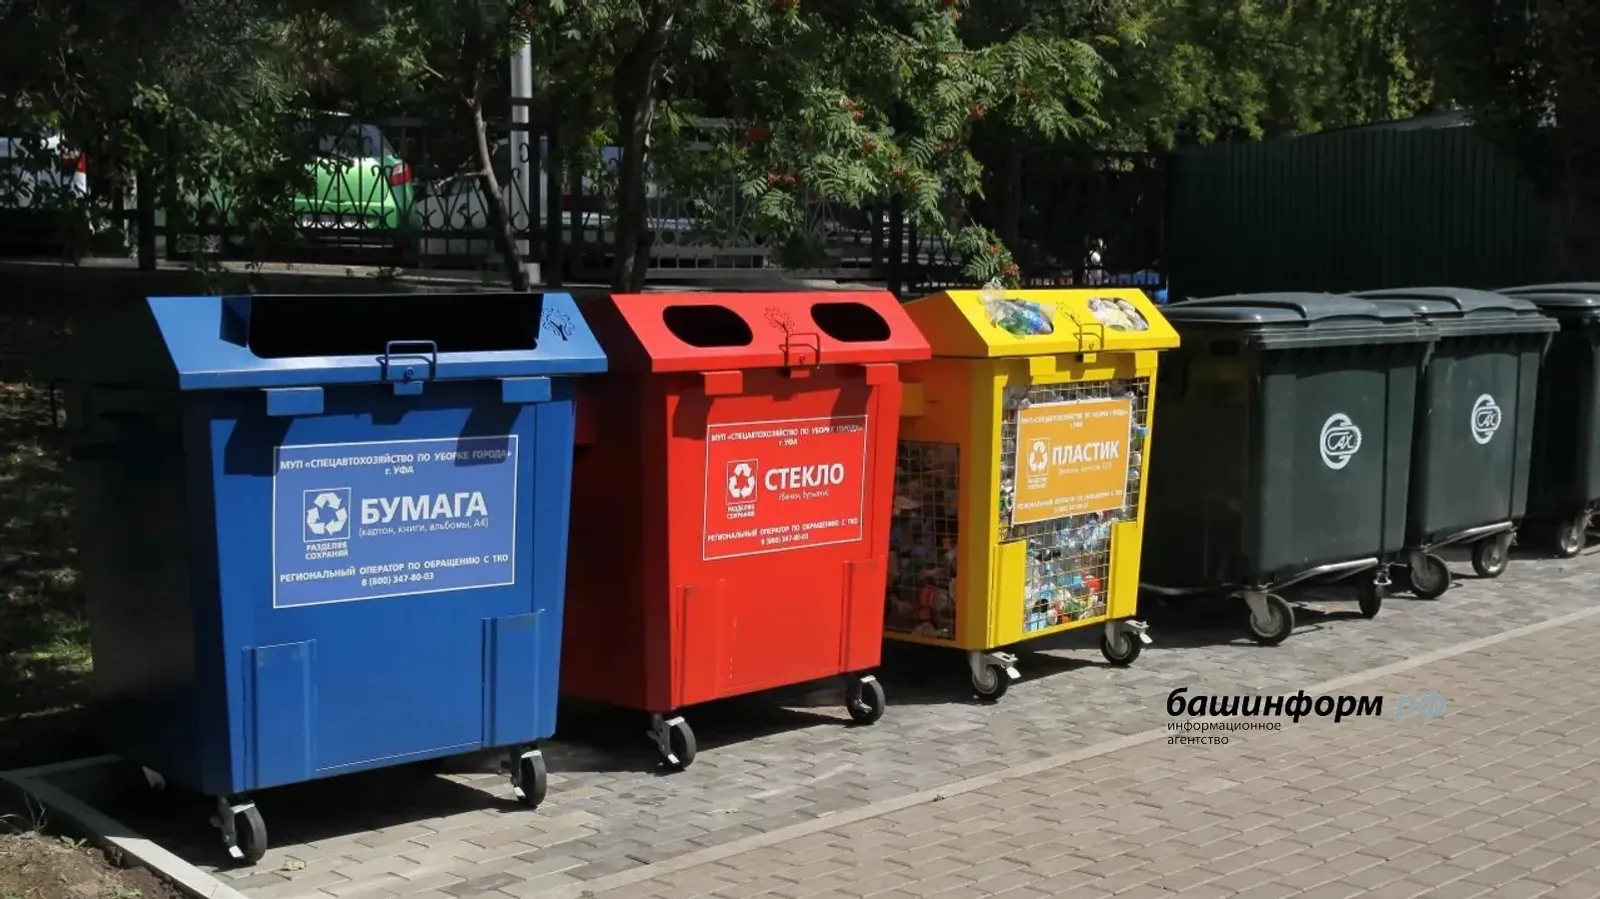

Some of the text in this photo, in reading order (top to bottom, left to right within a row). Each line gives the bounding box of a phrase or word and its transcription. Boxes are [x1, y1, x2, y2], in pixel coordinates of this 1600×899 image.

[281, 459, 303, 469] МУП
[417, 453, 431, 461] ПО
[435, 451, 469, 461] УБОРКЕ
[1052, 440, 1120, 466] ПЛАСТИК
[393, 466, 414, 474] УФА
[765, 463, 844, 491] СТЕКЛО
[361, 491, 488, 525] БУМАГА
[359, 526, 396, 538] (картон,
[398, 524, 427, 534] книги,
[430, 519, 472, 532] альбомы,
[280, 554, 508, 582] РЕГИОНАЛЬНЫЙ ОПЕРАТОР ПО ОБРАЩЕНИЮ С ТКО
[362, 572, 434, 587] 8 (800) 347-80-03
